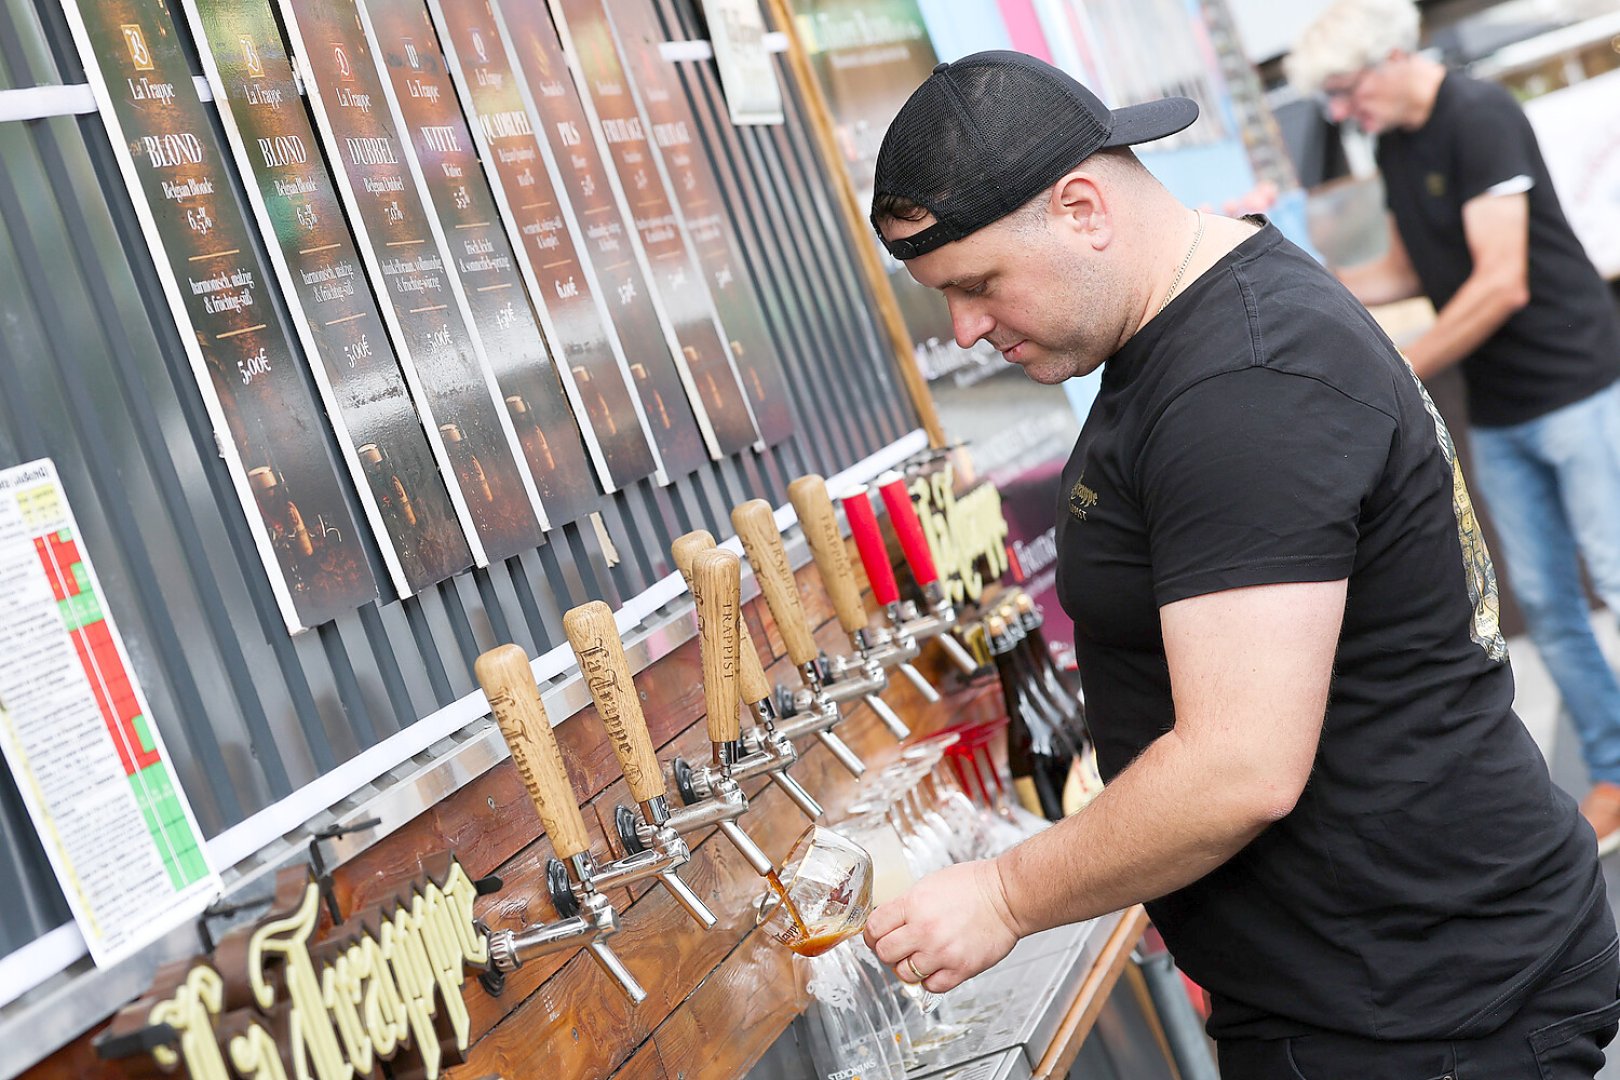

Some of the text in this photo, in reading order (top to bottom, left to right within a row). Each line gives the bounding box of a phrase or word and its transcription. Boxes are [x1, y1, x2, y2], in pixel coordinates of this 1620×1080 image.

[128, 77, 175, 105] La Trappe
[244, 84, 283, 109] La Trappe
[336, 88, 372, 113] La Trappe
[407, 80, 440, 103] La Trappe
[144, 133, 202, 168] BLOND
[257, 135, 307, 168] BLOND
[345, 137, 399, 164] DUBBEL
[420, 126, 462, 152] WITTE
[203, 297, 214, 314] &
[344, 334, 372, 368] 5,00€
[427, 324, 453, 354] 5,00€
[237, 348, 271, 385] 5,00€
[769, 541, 800, 607] TRAPPIST
[721, 601, 734, 680] TRAPPIST
